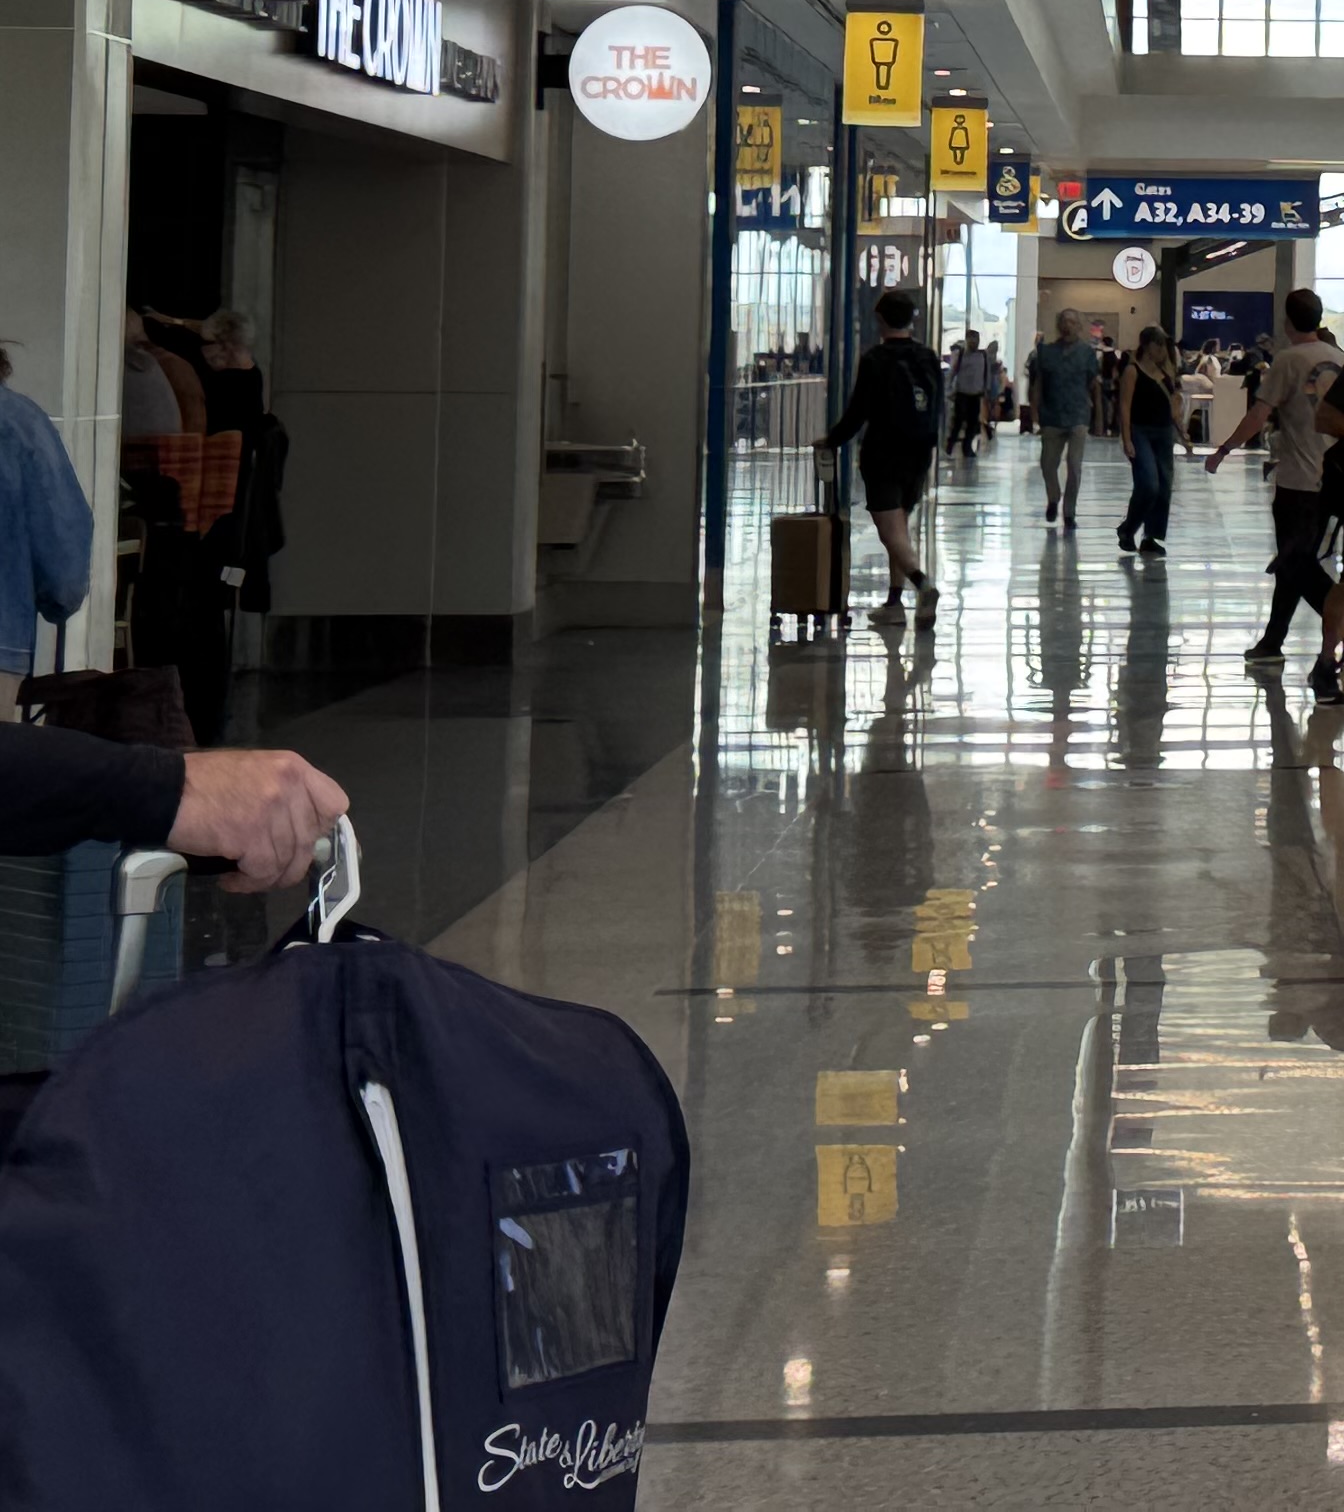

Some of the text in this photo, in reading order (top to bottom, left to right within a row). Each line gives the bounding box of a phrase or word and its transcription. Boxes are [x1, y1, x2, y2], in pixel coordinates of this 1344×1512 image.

[607, 45, 672, 70] THE
[580, 72, 698, 101] CROWN
[1134, 201, 1267, 227] A32, A34-39
